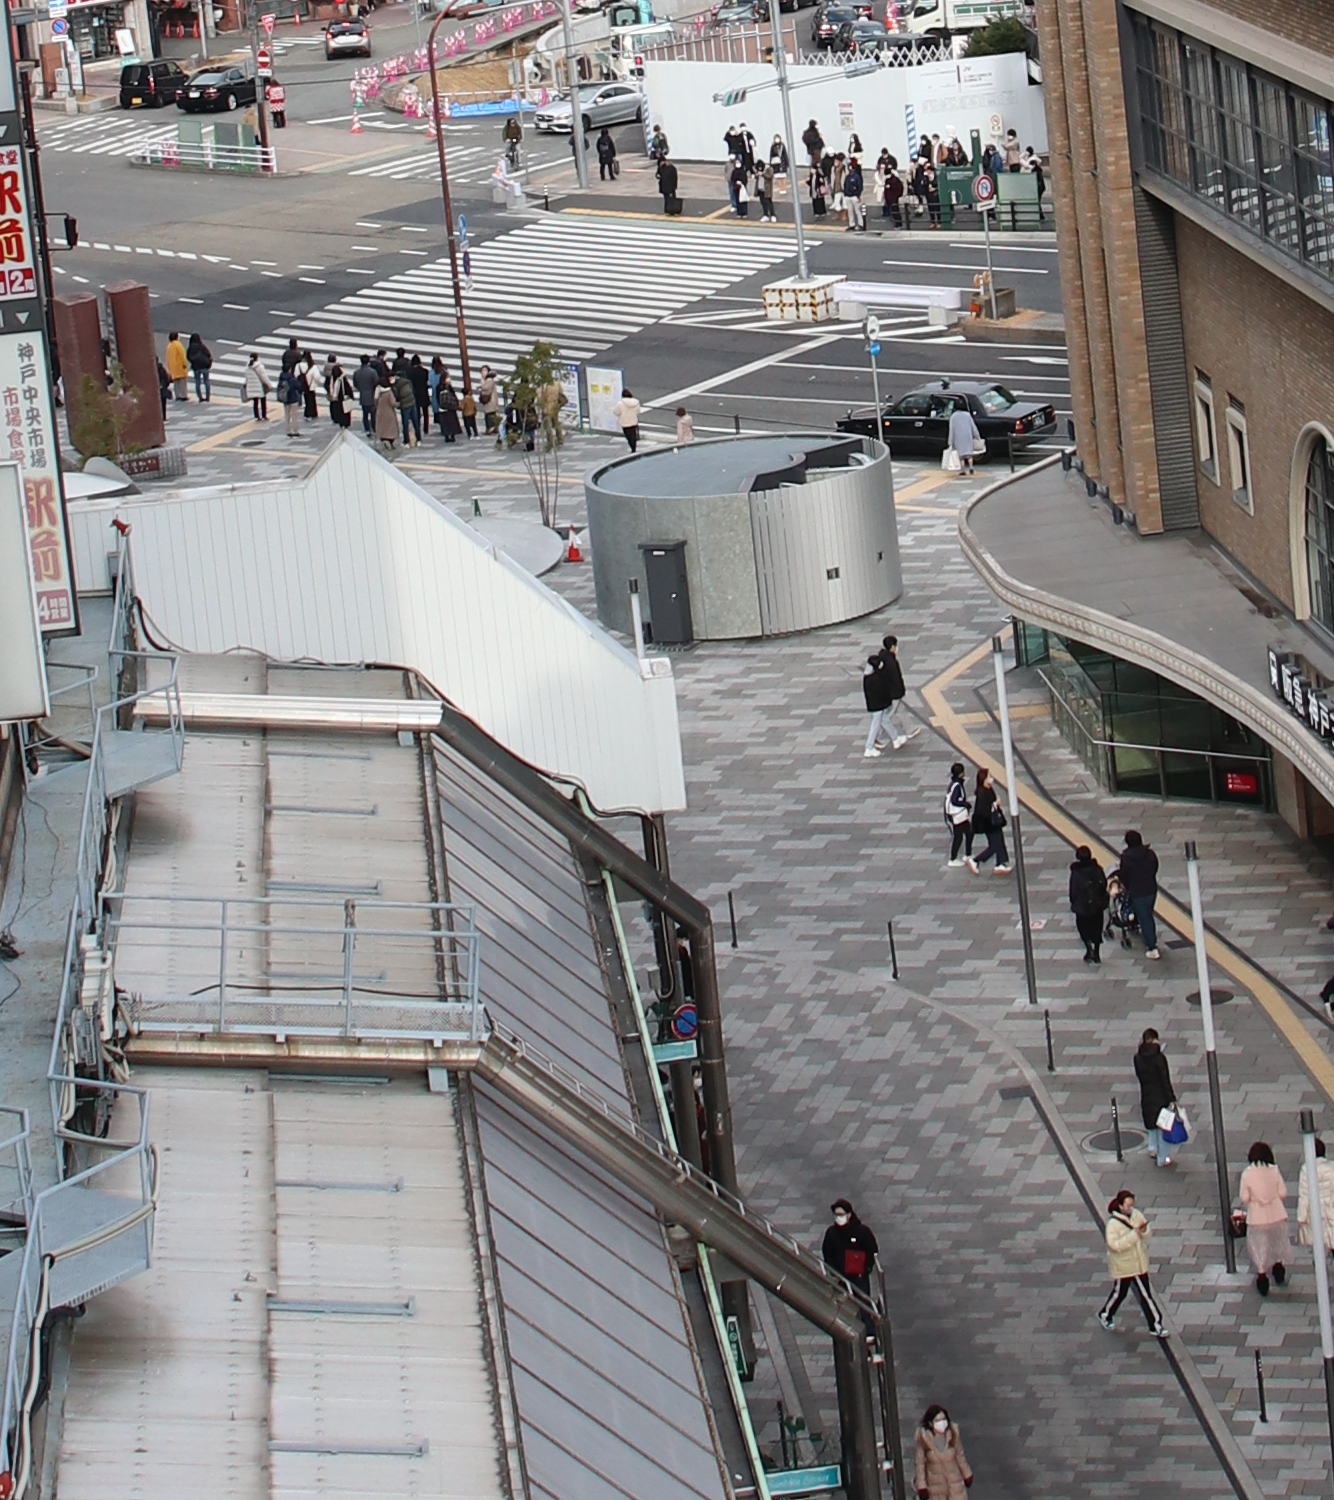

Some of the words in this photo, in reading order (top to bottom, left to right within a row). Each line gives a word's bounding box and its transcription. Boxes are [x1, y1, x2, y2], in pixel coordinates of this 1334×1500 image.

[17, 343, 48, 469] 神戸中央市場
